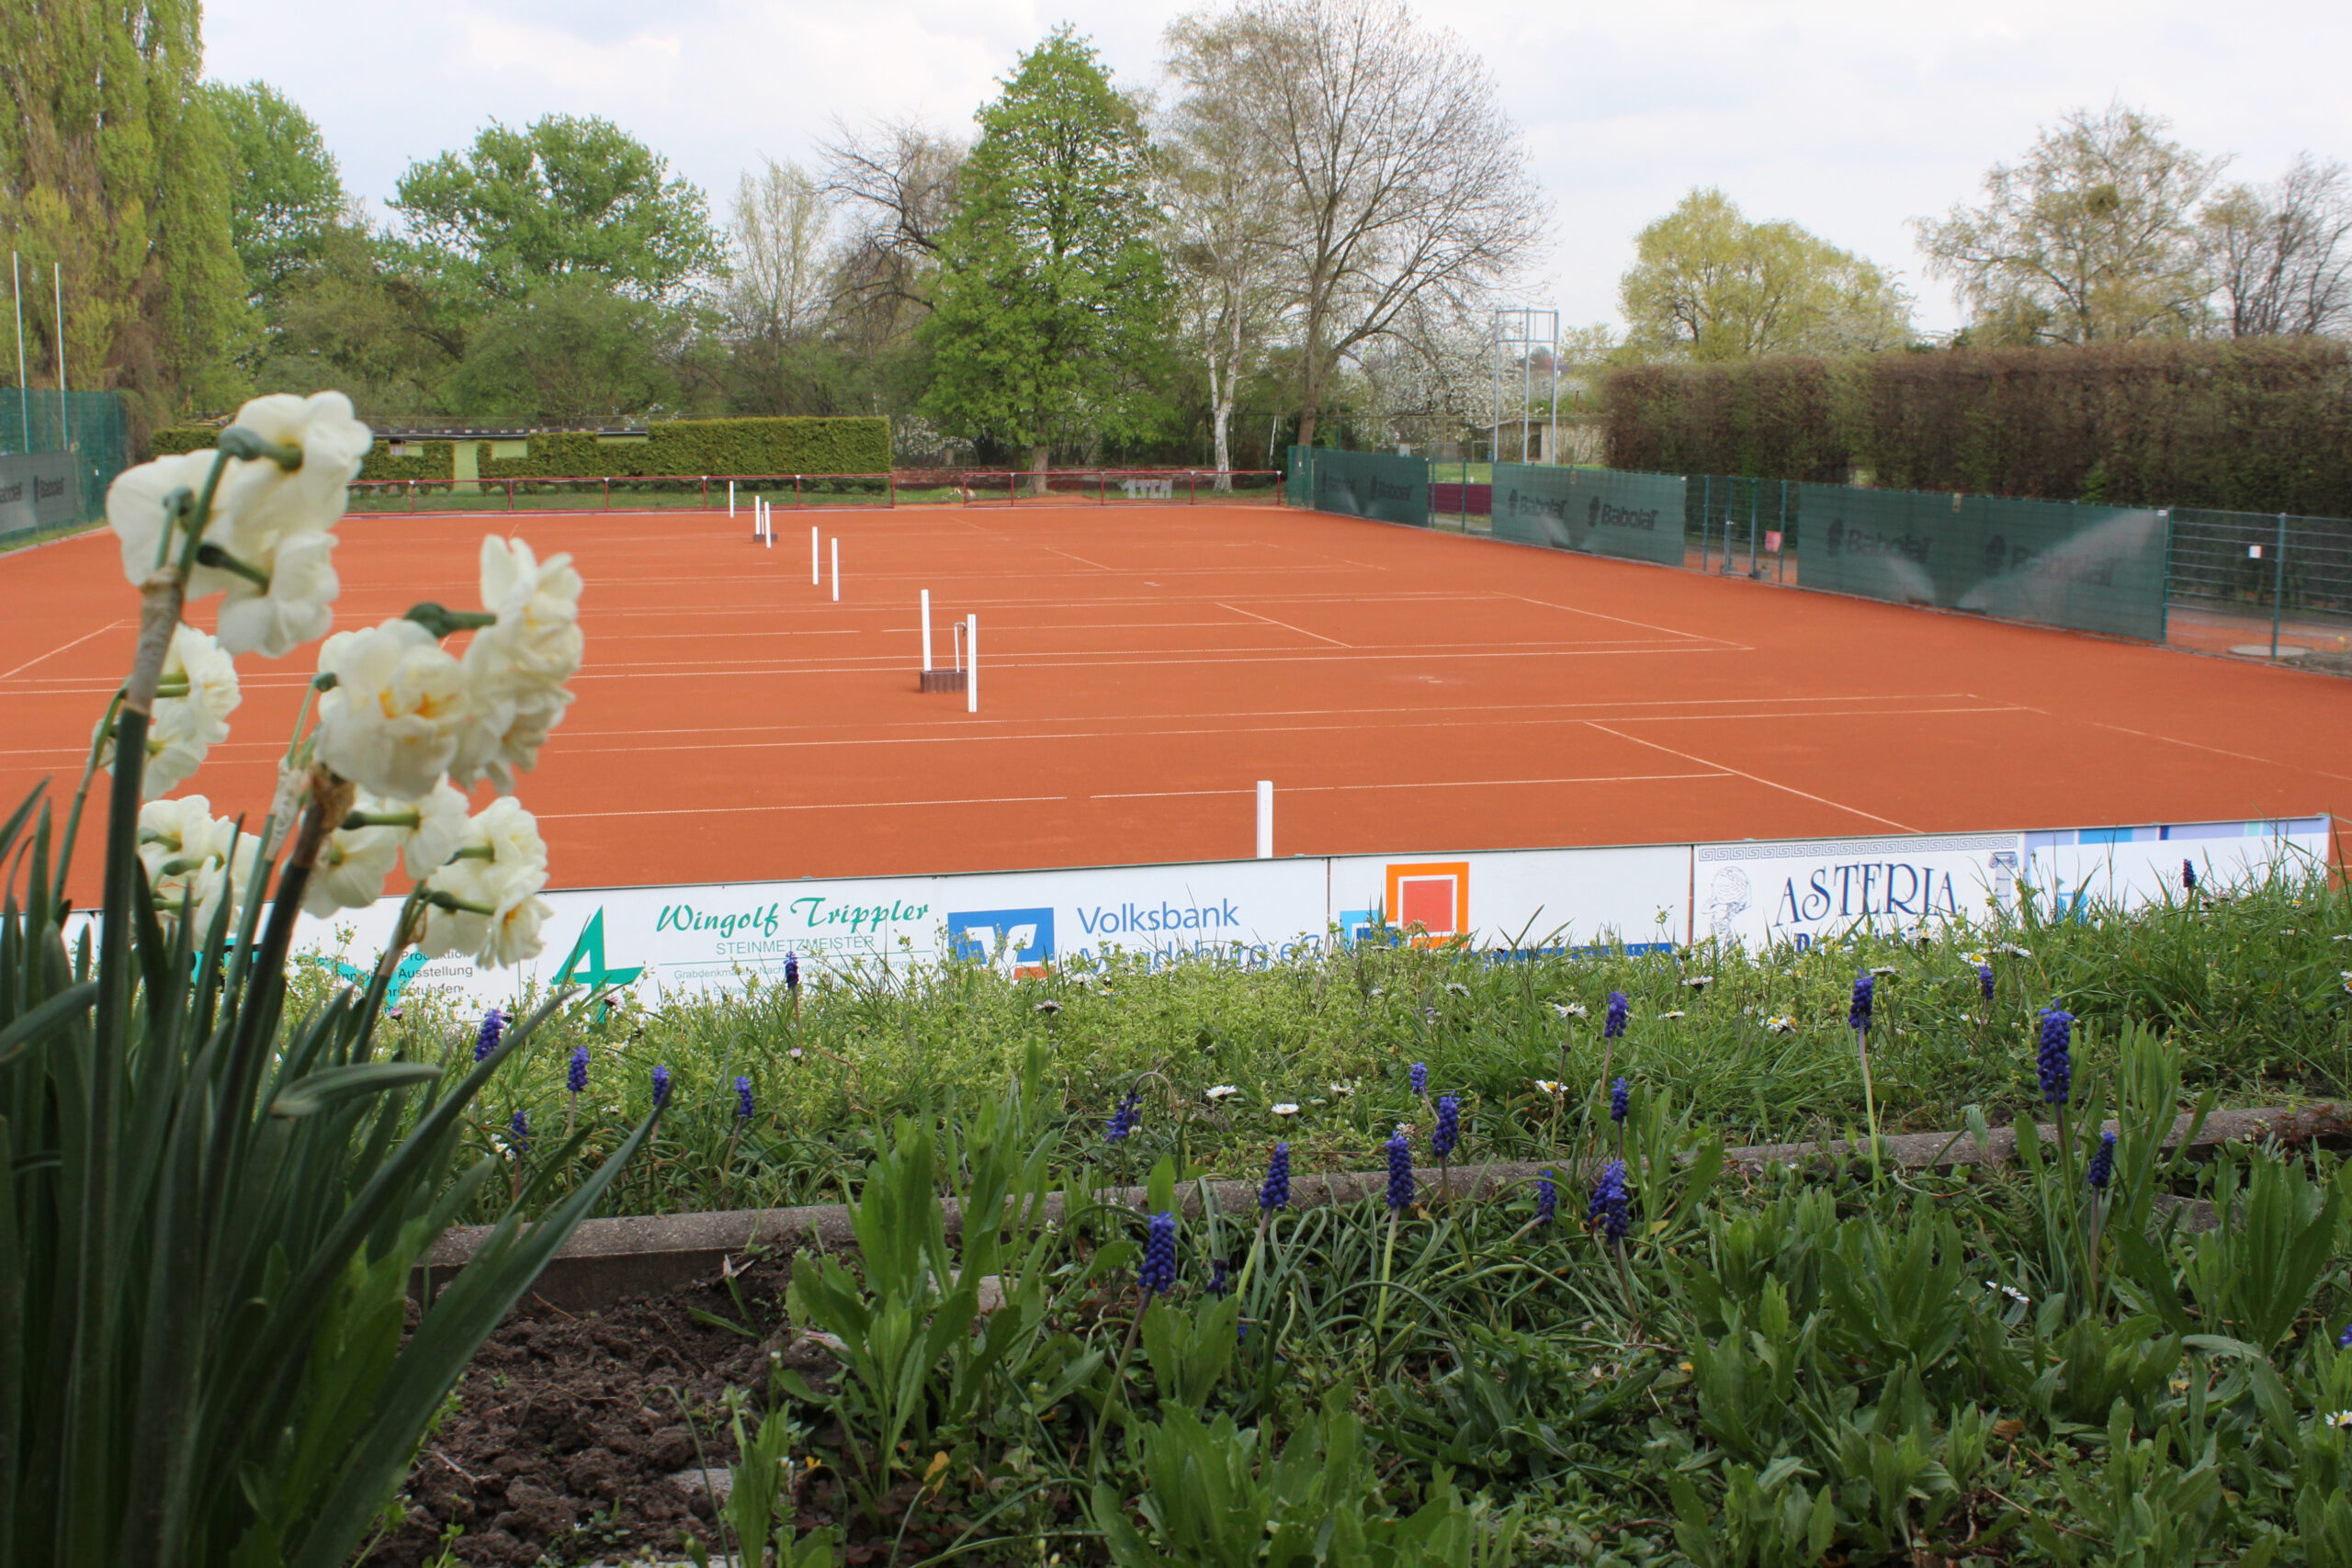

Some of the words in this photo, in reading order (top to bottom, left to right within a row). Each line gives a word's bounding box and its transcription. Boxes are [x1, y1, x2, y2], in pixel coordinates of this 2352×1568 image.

[1773, 861, 1959, 927] ASTERIA
[656, 902, 779, 939] Wingolf
[790, 897, 929, 934] Trippler
[1077, 897, 1240, 934] Volksbank
[401, 949, 471, 962] Proktion
[716, 935, 875, 955] STEINMETZMEISTER
[1079, 940, 1268, 975] Mgdeburg
[398, 964, 473, 978] Ausstellung
